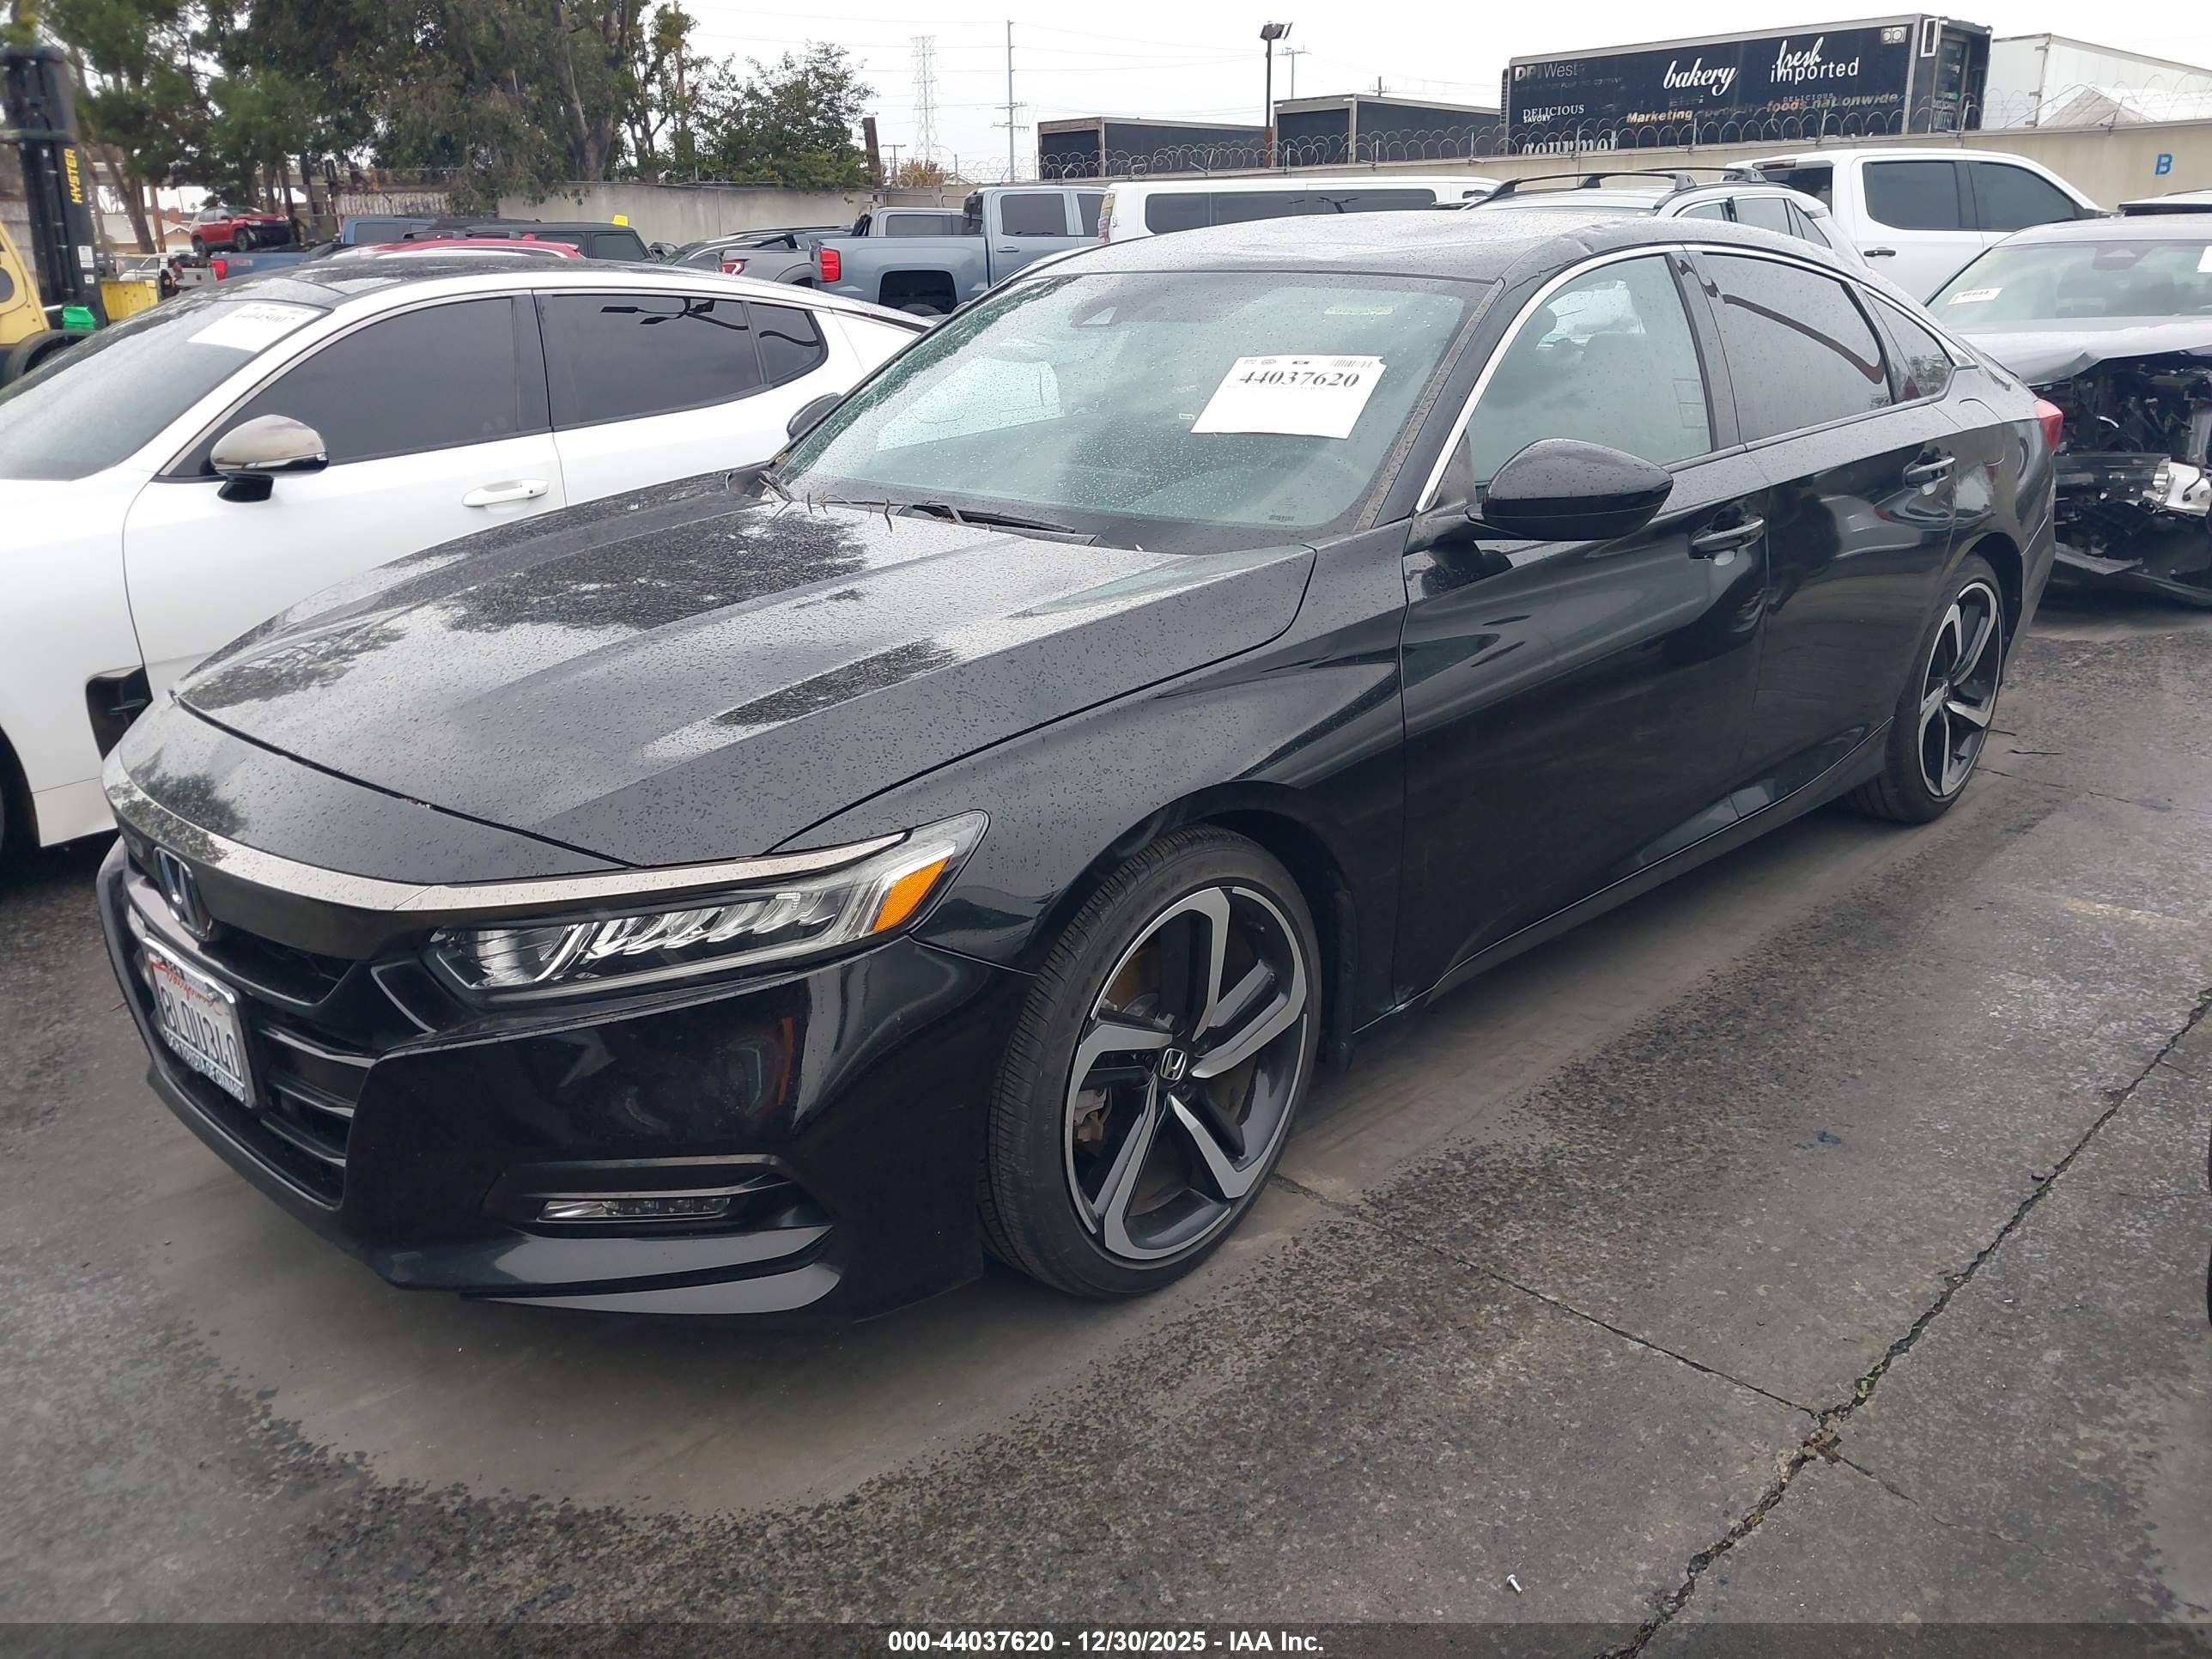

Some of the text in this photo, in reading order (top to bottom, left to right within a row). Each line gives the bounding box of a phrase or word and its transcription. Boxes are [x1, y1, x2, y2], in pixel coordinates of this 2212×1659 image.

[1775, 36, 1825, 81] fresh
[1662, 58, 1739, 96] bakery
[1770, 57, 1861, 85] imported
[1522, 104, 1586, 118] DELICIOUS
[1522, 113, 1552, 124] SAVORY
[1626, 109, 1694, 124] Marketing
[2155, 154, 2173, 175] B
[64, 148, 83, 204] HYSTER
[1239, 370, 1361, 388] 44037620
